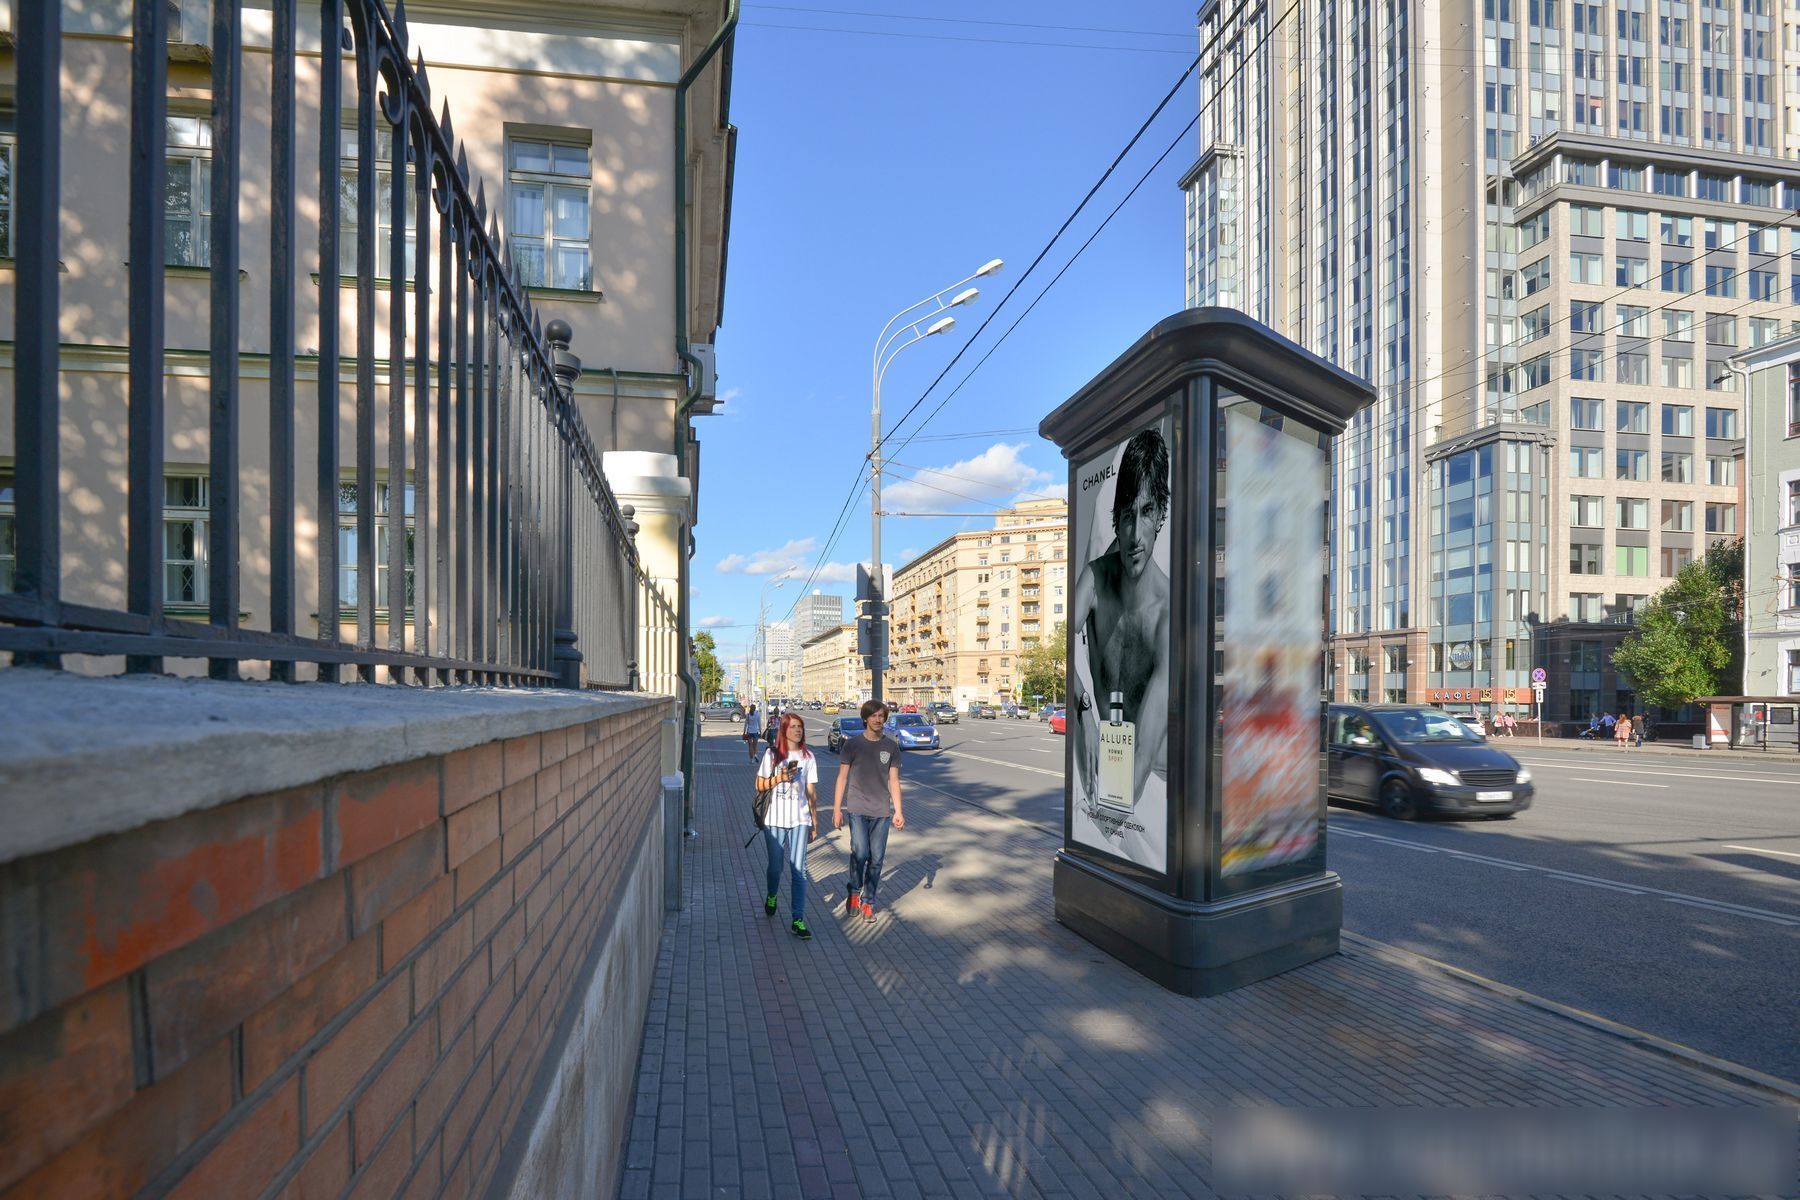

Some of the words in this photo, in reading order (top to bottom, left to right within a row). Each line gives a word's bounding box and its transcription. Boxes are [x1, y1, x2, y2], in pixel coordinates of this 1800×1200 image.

[1082, 464, 1116, 491] CHANEL
[1434, 691, 1471, 700] КАФЕ
[1101, 733, 1132, 745] ALLURE
